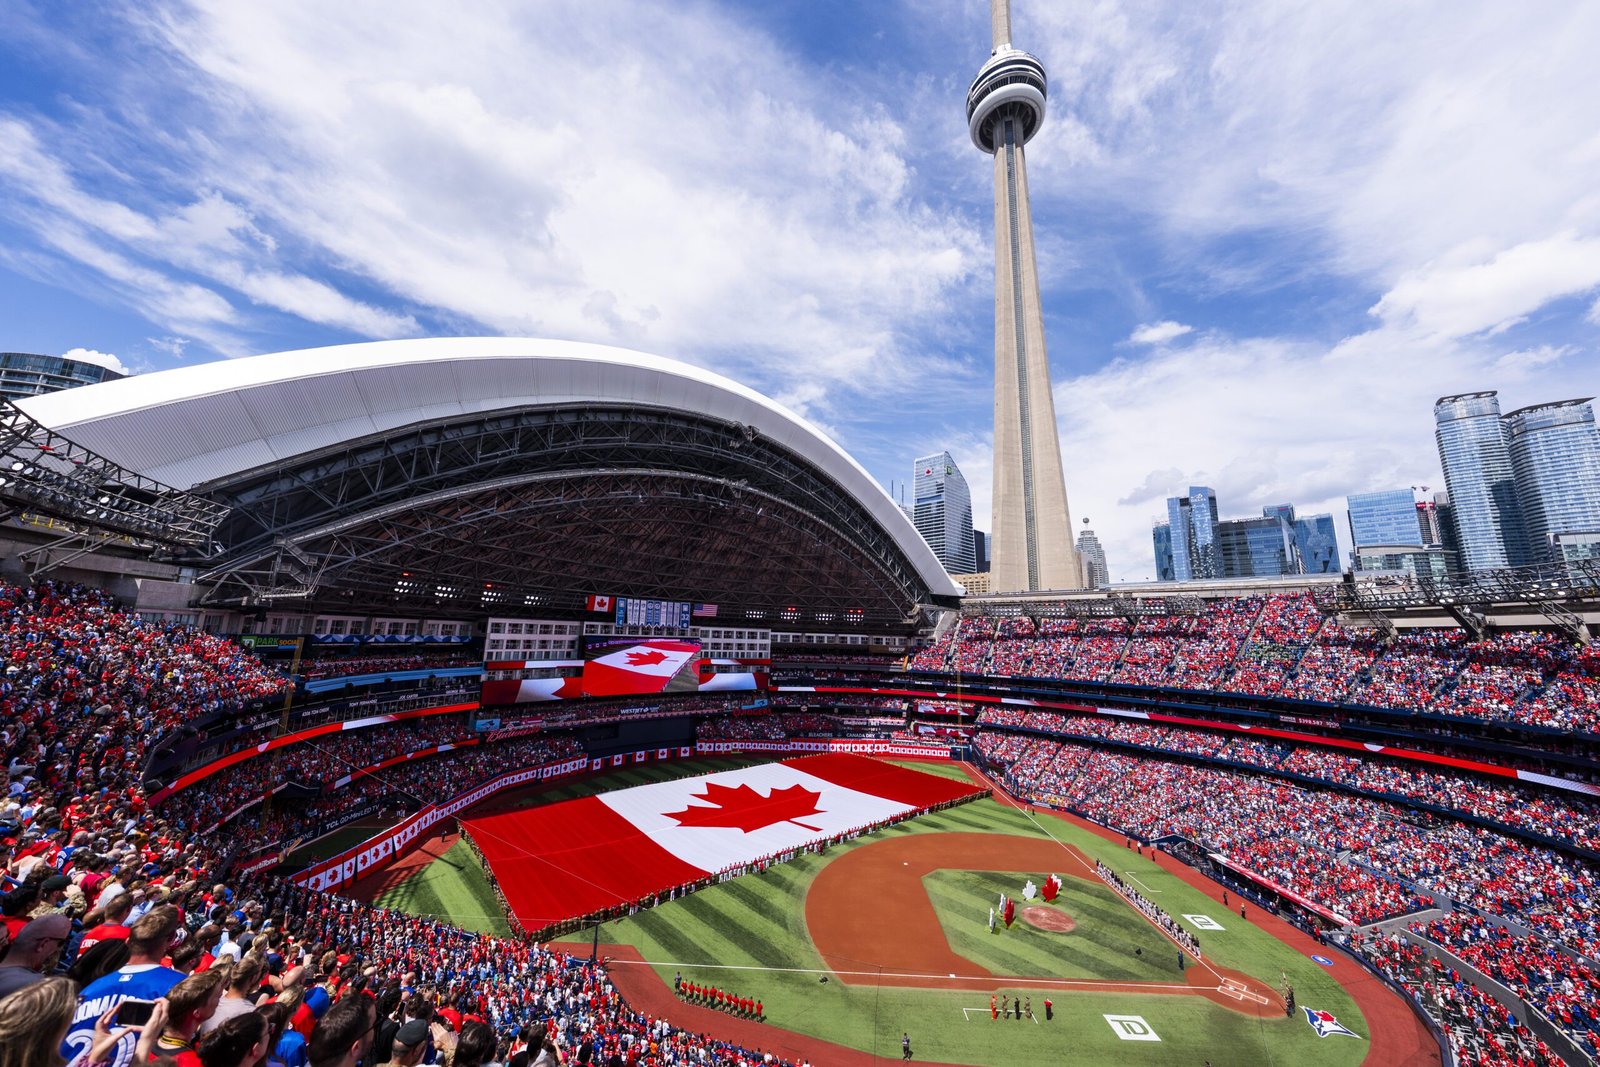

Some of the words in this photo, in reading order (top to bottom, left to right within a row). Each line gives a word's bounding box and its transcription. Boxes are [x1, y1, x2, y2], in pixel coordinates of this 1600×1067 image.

[256, 637, 279, 645] PARK
[740, 708, 772, 716] ROGERS
[486, 726, 541, 742] Budweiser
[326, 820, 339, 829] TCL
[1110, 1019, 1150, 1035] TD
